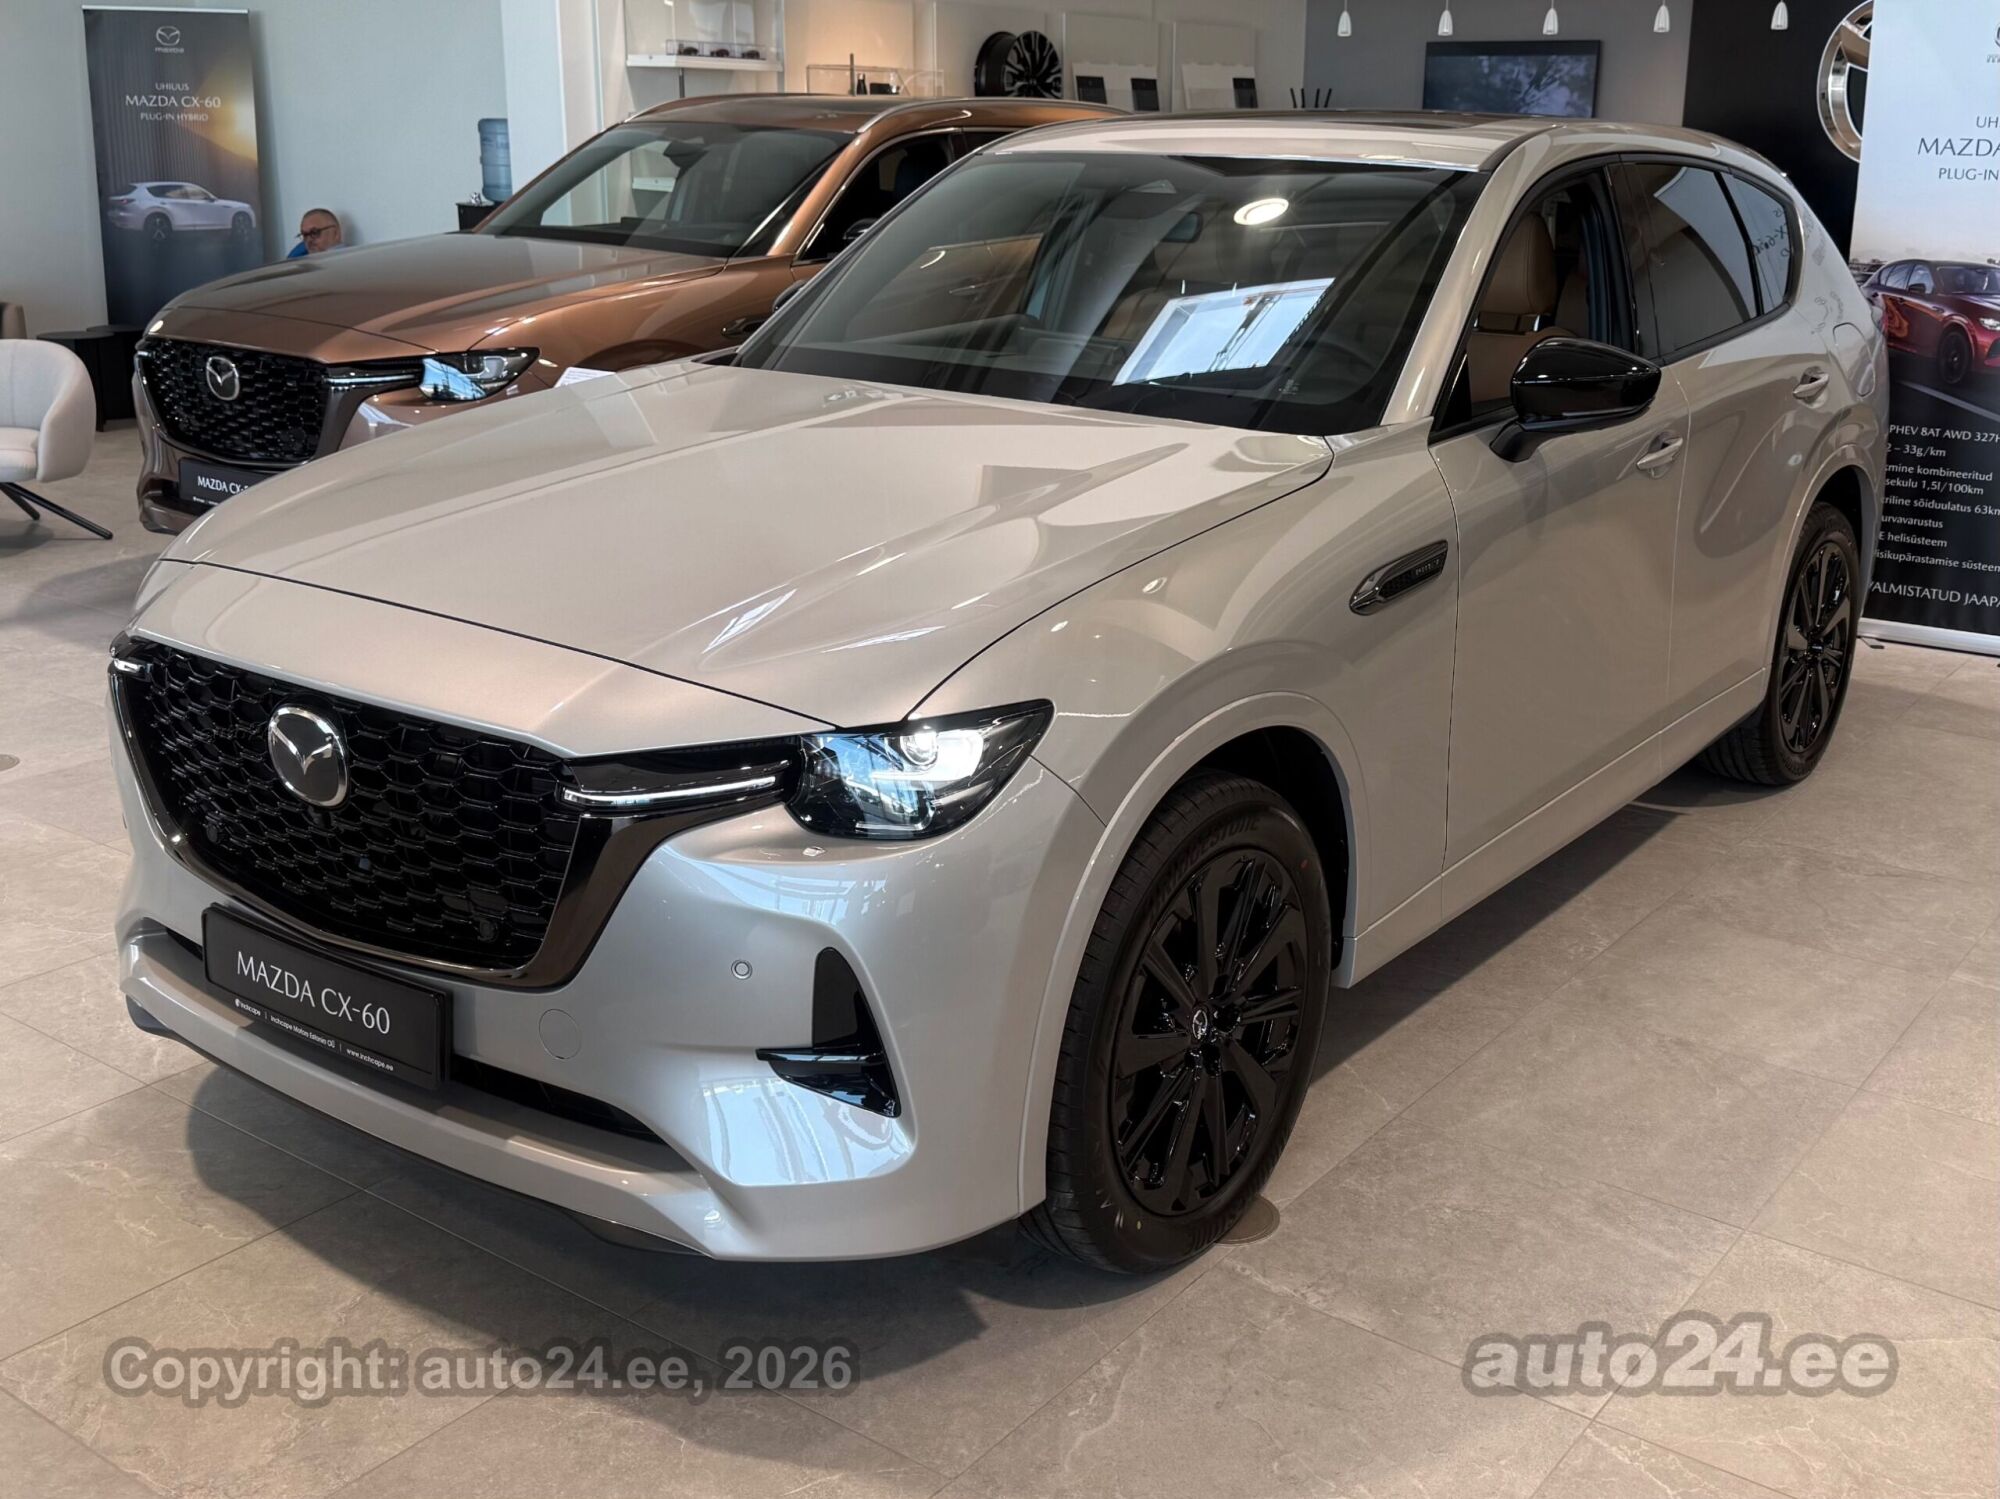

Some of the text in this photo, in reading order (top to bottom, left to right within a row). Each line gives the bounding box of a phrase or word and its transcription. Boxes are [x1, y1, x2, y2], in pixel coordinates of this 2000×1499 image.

[125, 95, 222, 109] MAZDA CX-60
[140, 112, 209, 122] PLUG-IN HYBRID
[1976, 115, 2000, 129] UH
[1938, 167, 2000, 181] PLUG-IN
[1889, 424, 1919, 436] PHEV
[1920, 427, 1941, 438] 8AT
[1942, 429, 1972, 441] AWD
[1902, 444, 1947, 458] 33g/km
[1916, 464, 1993, 482] kombineeritud
[197, 475, 229, 493] MAZDA
[1887, 532, 1948, 548] helisüsteem
[236, 950, 391, 1035] MAZDA CX-60
